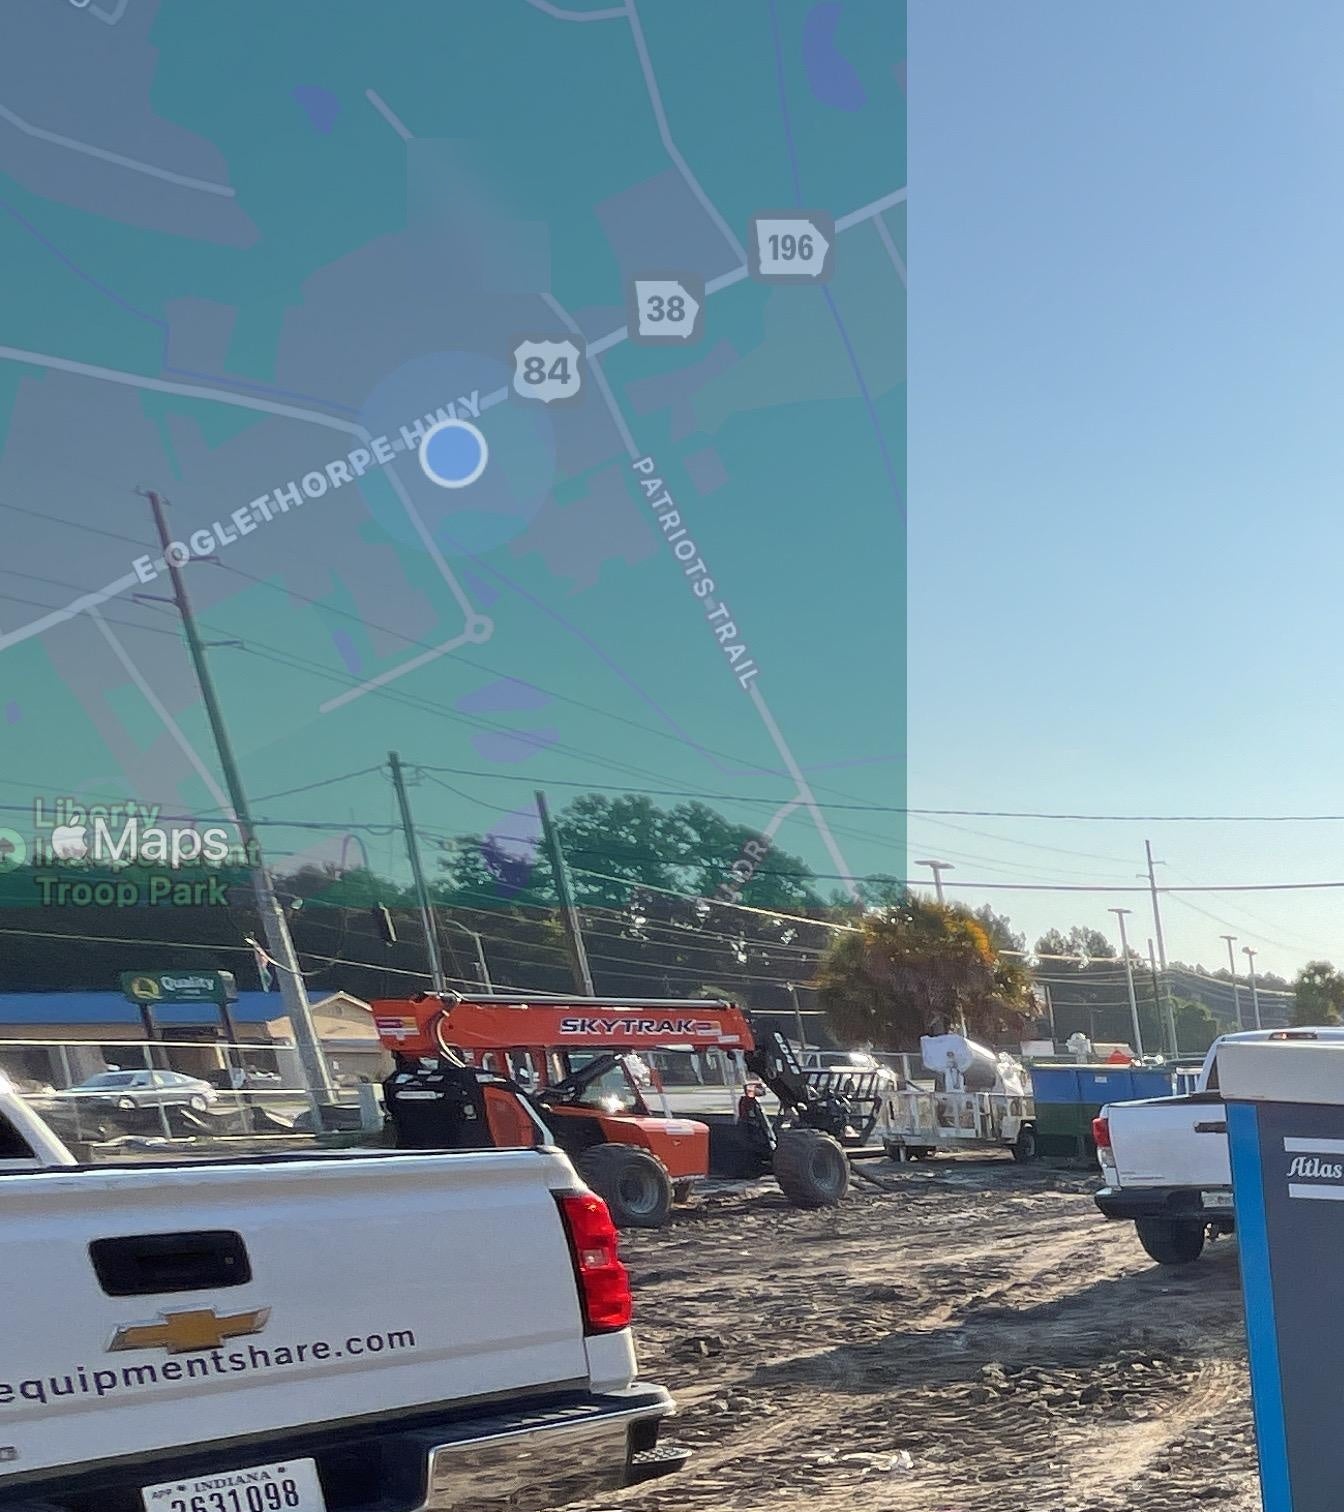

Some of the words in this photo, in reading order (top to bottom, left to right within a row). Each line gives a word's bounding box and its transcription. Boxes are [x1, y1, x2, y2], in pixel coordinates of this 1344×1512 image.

[560, 1018, 698, 1035] SKYTRAK
[1286, 1156, 1342, 1179] Atlas
[0, 1328, 417, 1404] equipmentshare.com
[193, 1471, 272, 1493] INDIANA
